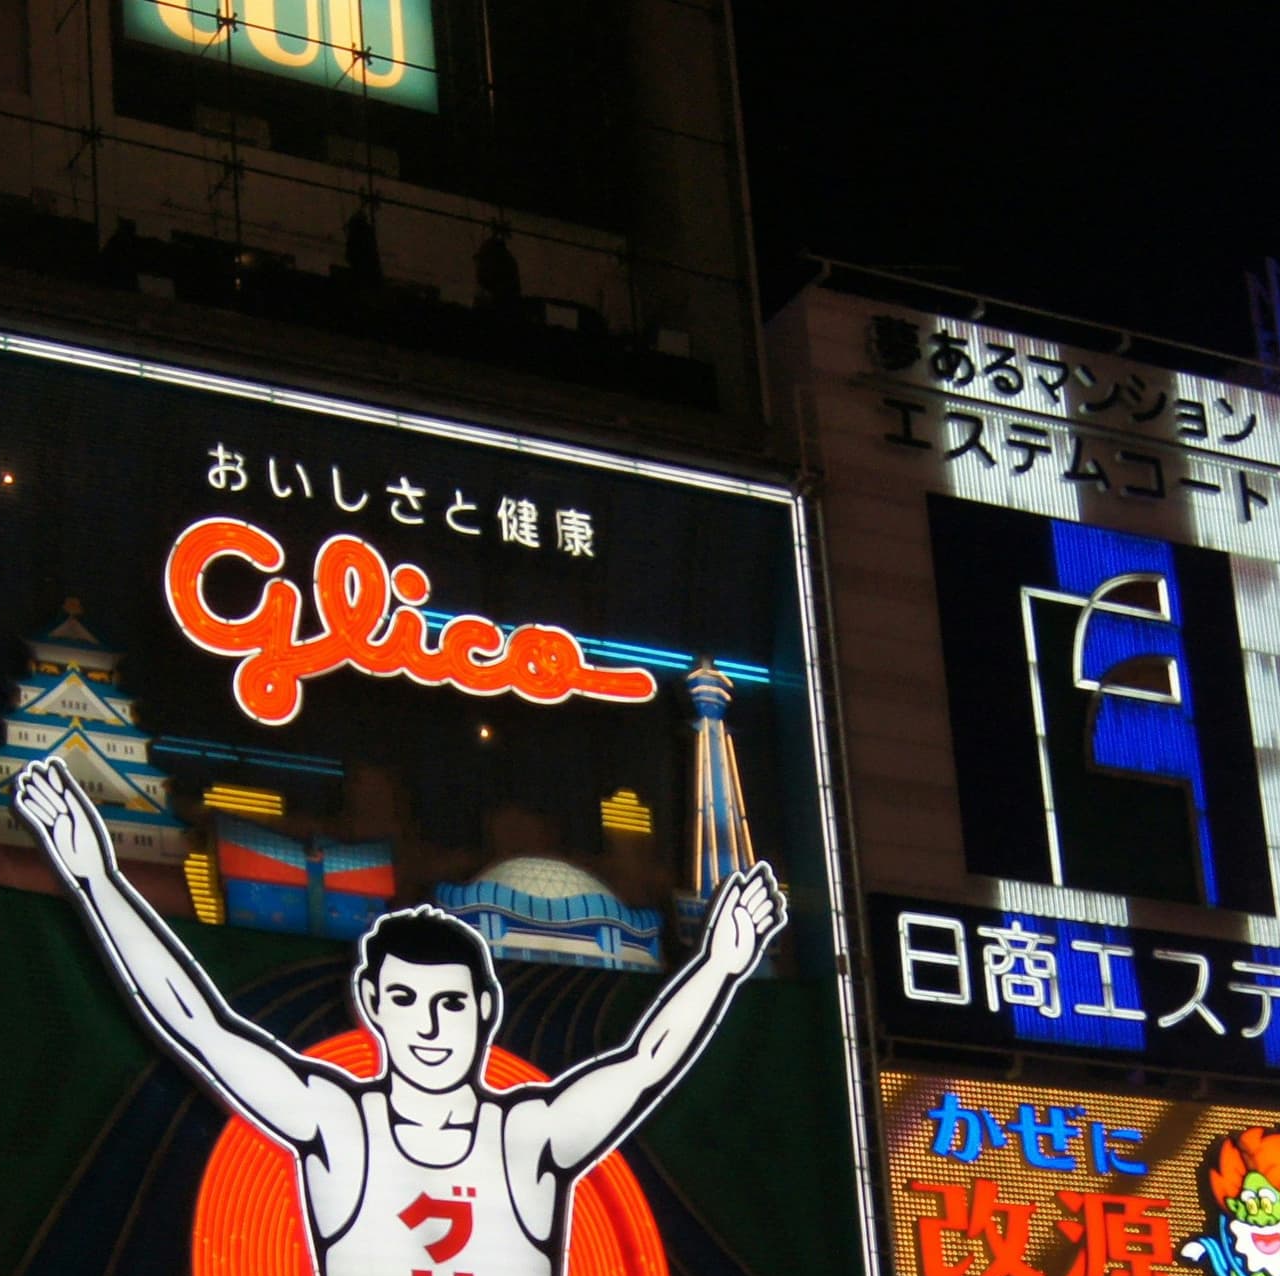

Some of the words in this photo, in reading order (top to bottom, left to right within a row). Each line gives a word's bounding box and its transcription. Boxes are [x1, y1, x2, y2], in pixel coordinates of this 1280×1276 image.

[207, 442, 596, 559] おいしさと健康
[883, 398, 1268, 522] エステムコート
[164, 516, 658, 727] Glico
[928, 1091, 1149, 1177] かぜに
